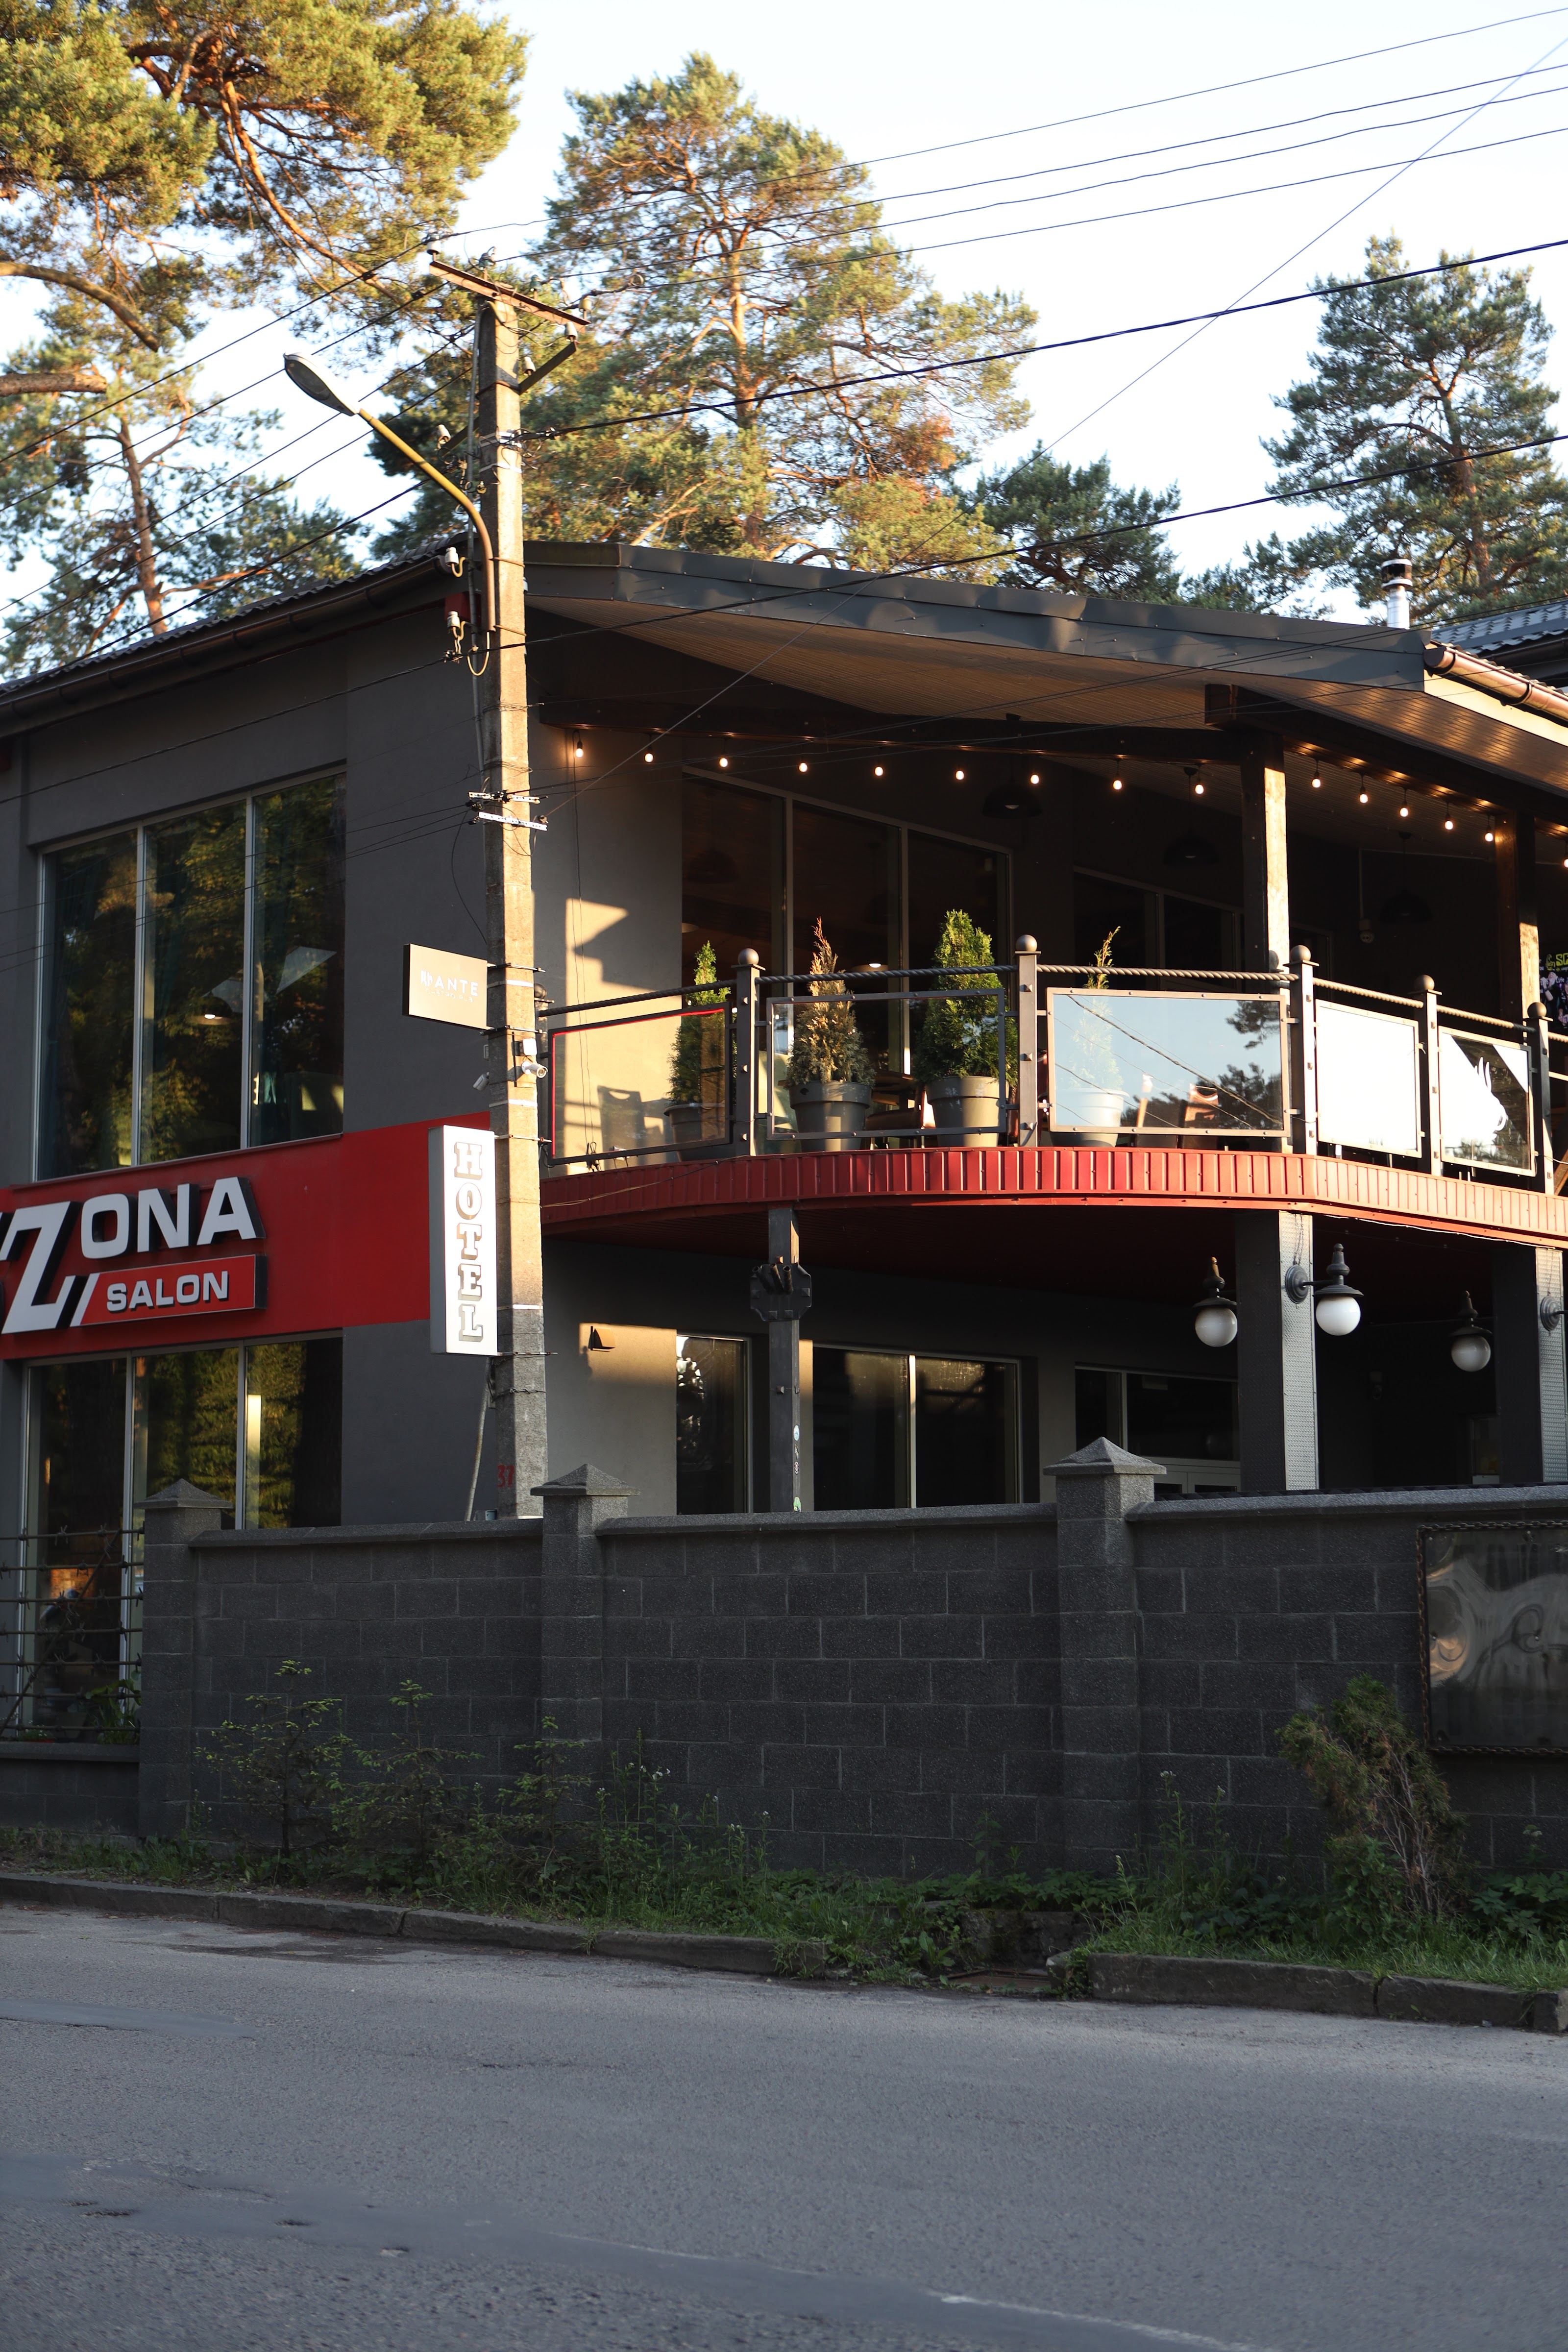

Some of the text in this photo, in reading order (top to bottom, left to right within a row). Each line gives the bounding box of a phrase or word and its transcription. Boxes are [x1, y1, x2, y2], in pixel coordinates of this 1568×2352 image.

[0, 1176, 257, 1334] ZONA
[106, 1271, 229, 1313] SALON
[454, 1141, 483, 1343] HOTEL
[496, 1465, 514, 1488] 37
